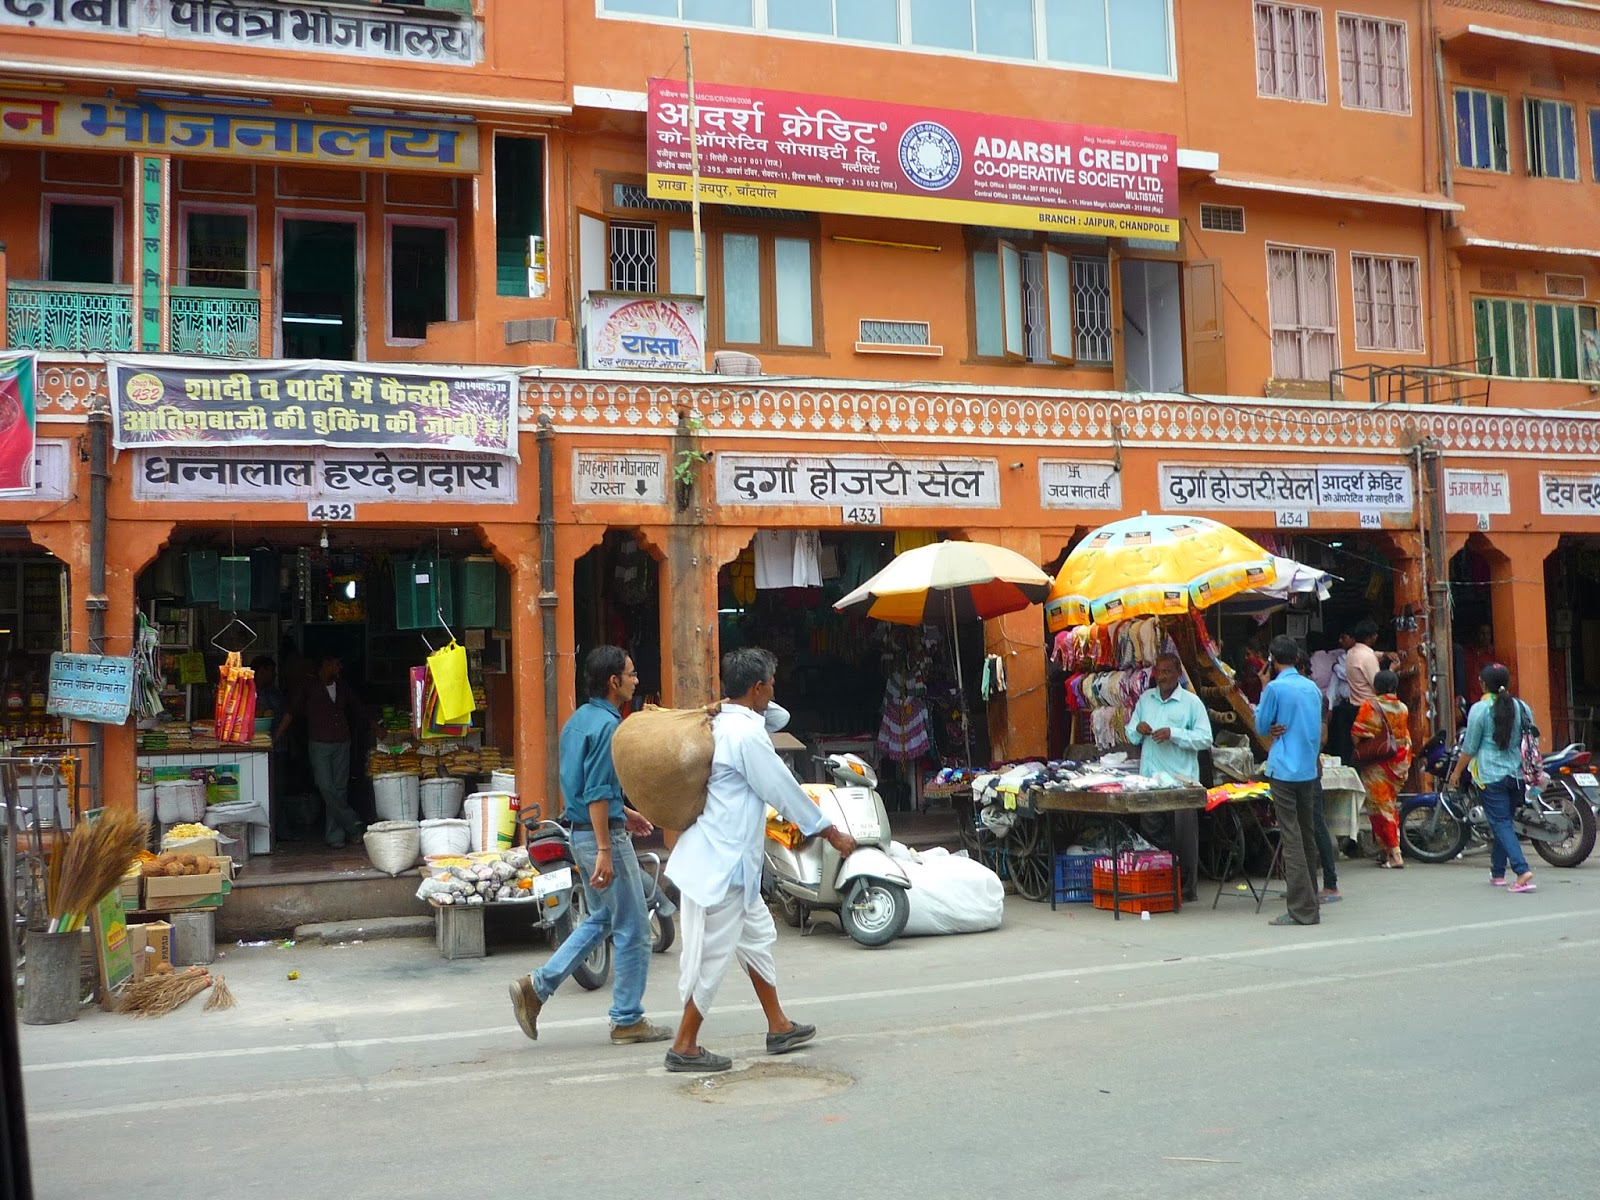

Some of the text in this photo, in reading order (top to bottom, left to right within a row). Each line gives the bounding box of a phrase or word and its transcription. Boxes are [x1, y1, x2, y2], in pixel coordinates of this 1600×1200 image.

[291, 8, 472, 61] भोजनालय
[657, 101, 766, 133] आदर्श
[81, 101, 461, 164] भोजनालय
[775, 138, 848, 162] सोसाइटी
[854, 146, 881, 164] लि.
[973, 136, 1072, 166] ADARSH
[841, 161, 880, 175] मल्टीस्टेट
[973, 159, 1164, 193] CO-OPERATIVE SOCIETY LTD.
[656, 179, 687, 192] शाखा
[989, 181, 1004, 189] Office
[1023, 194, 1040, 202] Adarsh
[1109, 202, 1131, 210] UDAIPUR
[1125, 190, 1163, 204] MULTISTATE
[1038, 213, 1076, 226] BRANCH
[1083, 216, 1118, 230] JAIPUR,
[1119, 219, 1170, 234] CHANDPOLE
[620, 334, 680, 357] रास्ता
[131, 380, 148, 389] Shop
[131, 387, 160, 401] 432
[184, 373, 253, 401] शादी
[258, 378, 280, 401] व
[284, 374, 345, 403] पार्टी
[349, 376, 374, 404] में
[123, 405, 269, 431] आतिशबाजी
[272, 405, 307, 430] की
[312, 407, 380, 435] बुकिंग
[385, 409, 417, 434] की
[423, 412, 478, 437] जाती
[145, 451, 503, 494] धन्नालाल हरदेवदास
[577, 457, 659, 479] जय हनुमान भोजनालय
[590, 481, 626, 495] रास्ता
[733, 458, 985, 500] दुर्गा होजरी सेल
[1169, 470, 1314, 504] दुर्गा होजरी सेल
[1321, 471, 1403, 492] आदर्श क्रेडिट
[1458, 481, 1468, 496] जय
[1047, 482, 1111, 499] जय माता दी
[1365, 492, 1394, 505] सोसाइटी
[1545, 477, 1576, 508] देव
[311, 504, 353, 520] 432
[847, 507, 876, 523] 433
[1279, 512, 1303, 526] 434
